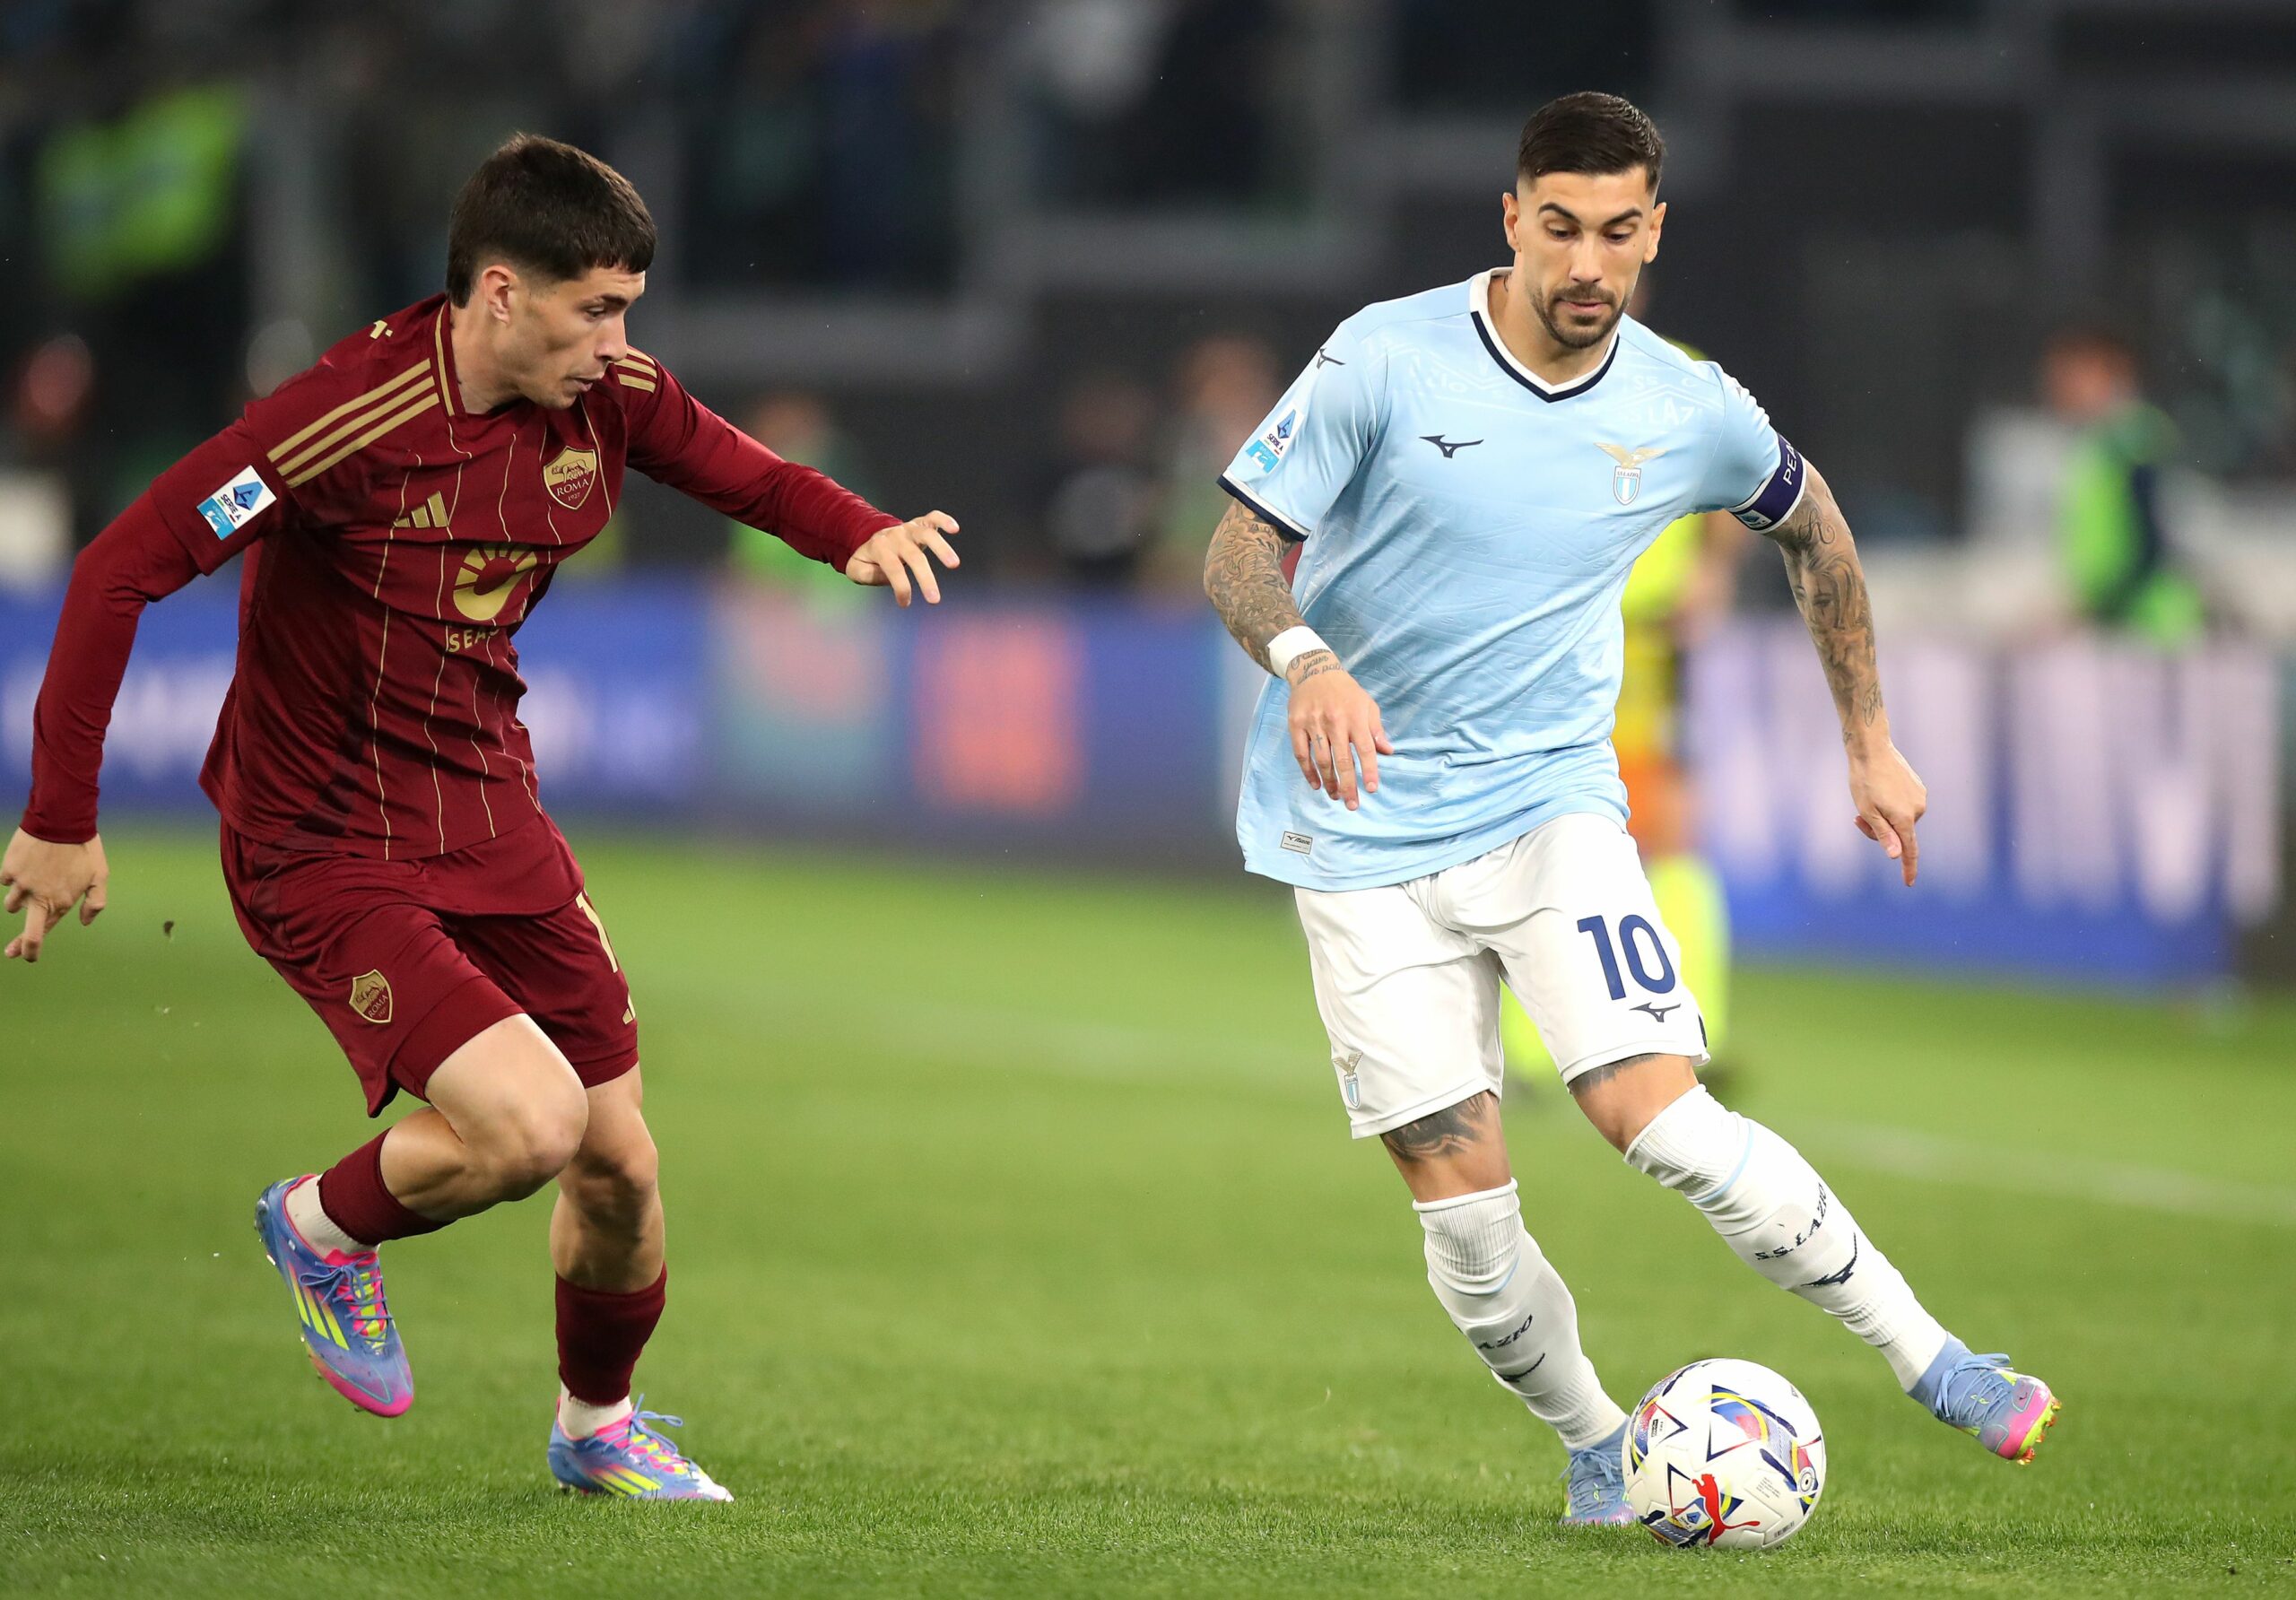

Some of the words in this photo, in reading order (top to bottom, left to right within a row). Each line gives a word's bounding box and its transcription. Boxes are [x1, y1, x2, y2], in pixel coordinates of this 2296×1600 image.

[1782, 442, 1797, 485] PEA
[556, 478, 589, 496] ROMA
[568, 491, 580, 501] 1927
[221, 493, 239, 515] SERIE
[1577, 914, 1675, 1001] 10
[369, 995, 388, 1017] ROMA
[1478, 1314, 1533, 1350] AZIO
